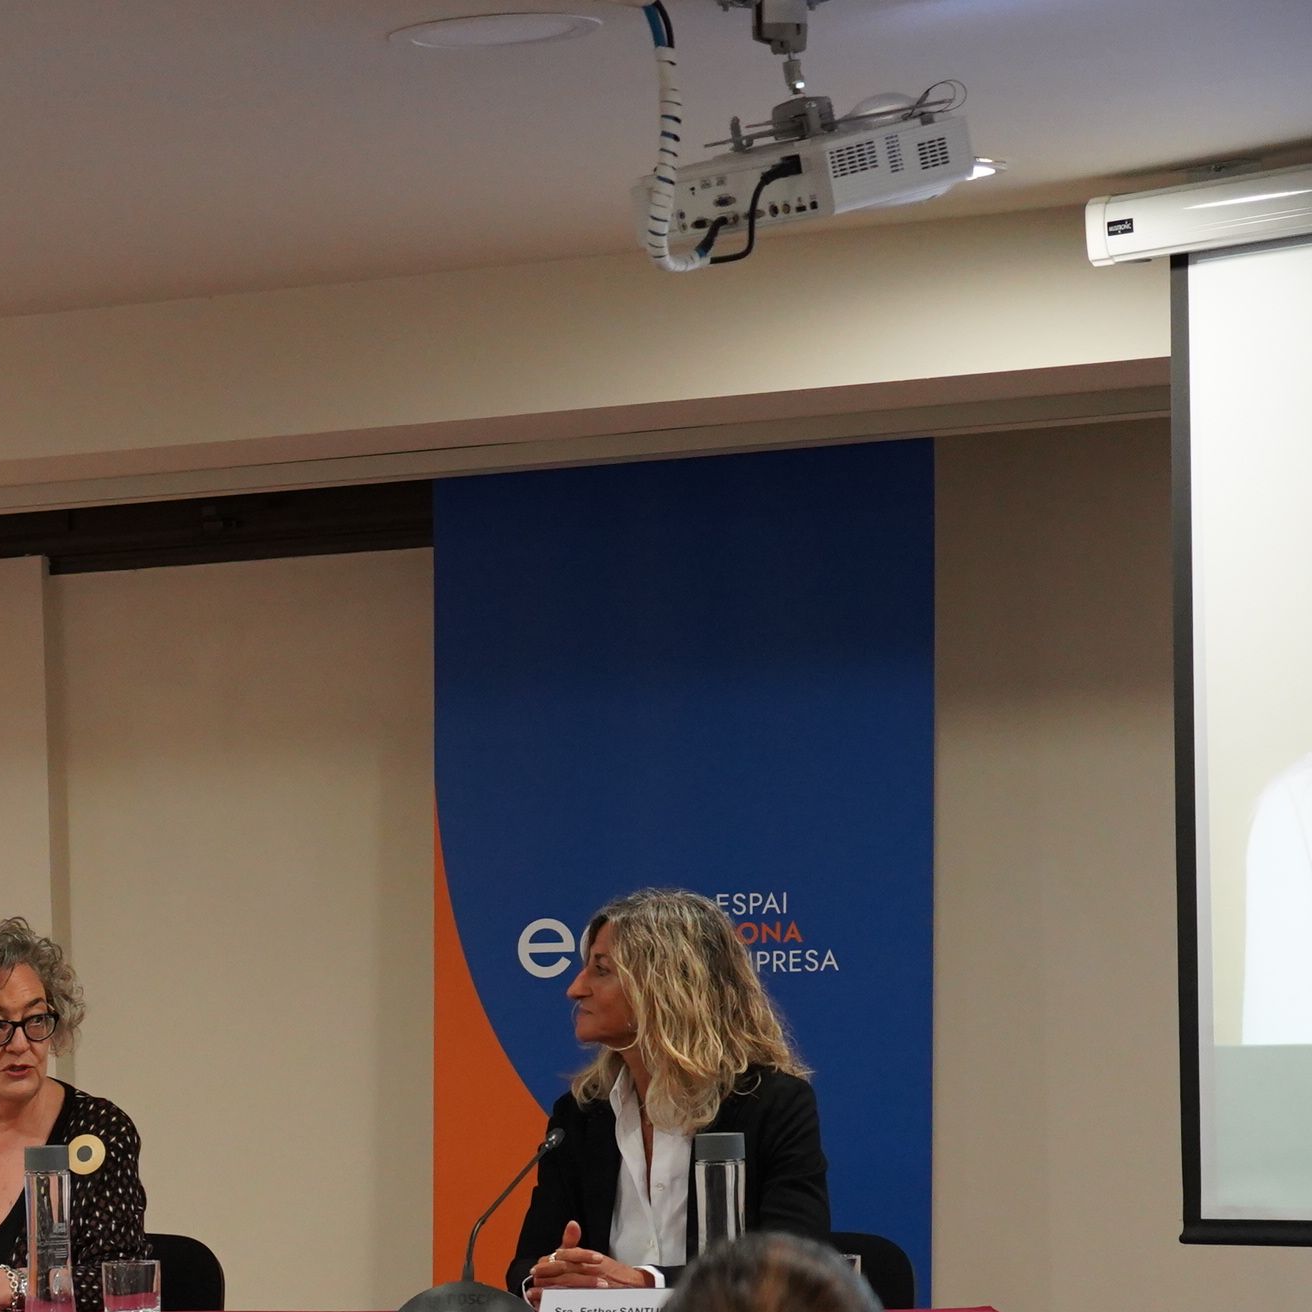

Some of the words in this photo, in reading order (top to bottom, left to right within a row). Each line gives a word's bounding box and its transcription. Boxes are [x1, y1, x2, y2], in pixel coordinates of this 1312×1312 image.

[716, 891, 787, 916] ESPAI
[736, 920, 804, 945] ONA
[748, 948, 839, 973] PRESA
